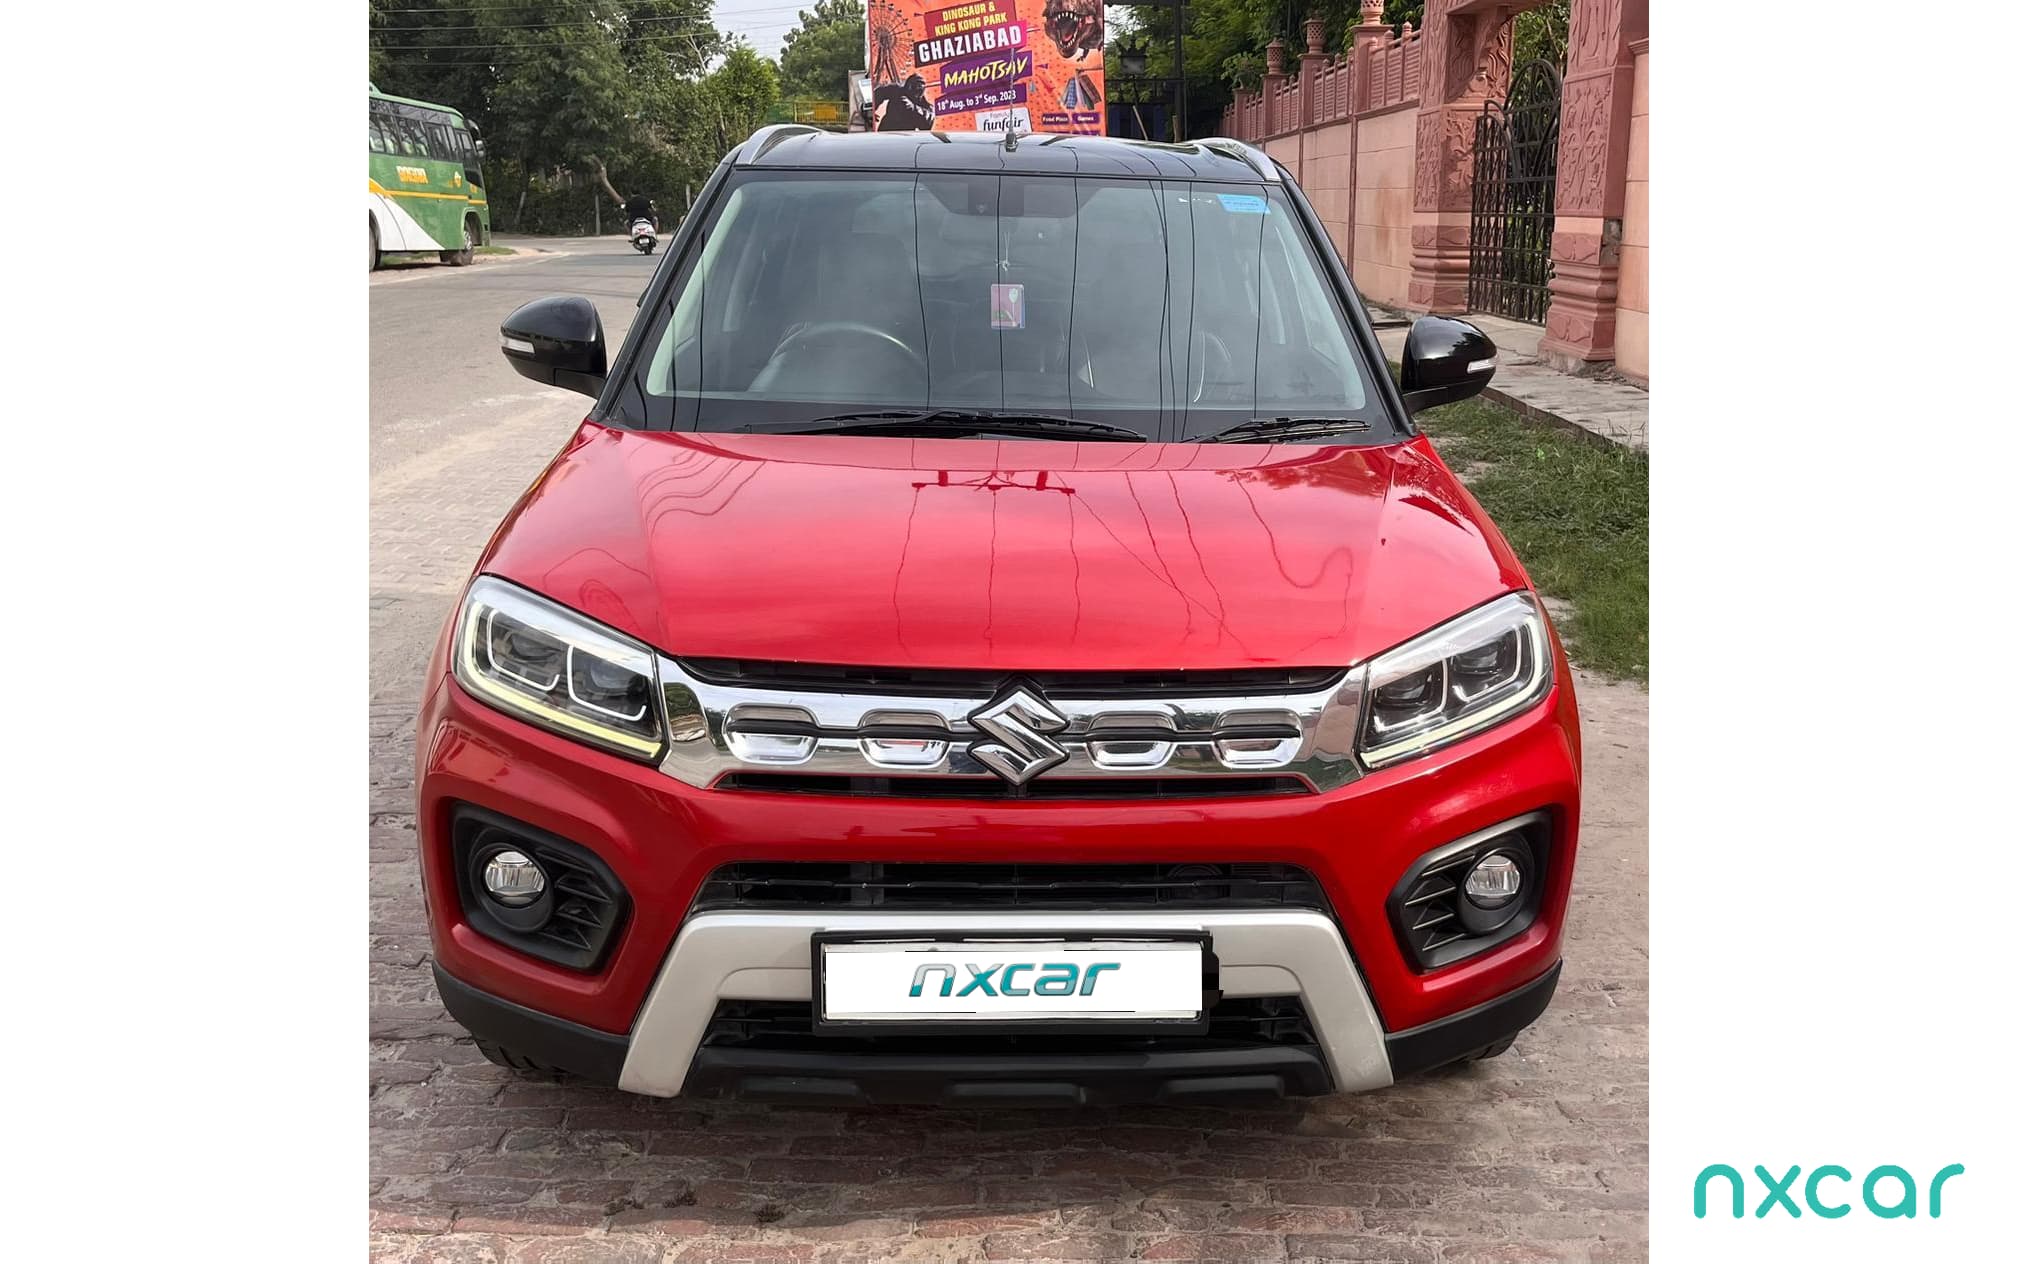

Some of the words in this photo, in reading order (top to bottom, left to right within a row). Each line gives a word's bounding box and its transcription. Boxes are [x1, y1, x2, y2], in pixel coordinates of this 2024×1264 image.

[943, 3, 986, 21] DINOSAUR
[989, 2, 995, 12] &
[935, 23, 956, 36] KING
[958, 17, 981, 31] KONG
[983, 12, 1007, 26] PARK
[918, 25, 1022, 62] GHAZIABAD
[944, 56, 1028, 88] MAHOTSAV
[950, 100, 965, 110] Aug.
[966, 98, 974, 106] to
[984, 94, 999, 104] Sep.
[1000, 90, 1016, 101] 2023
